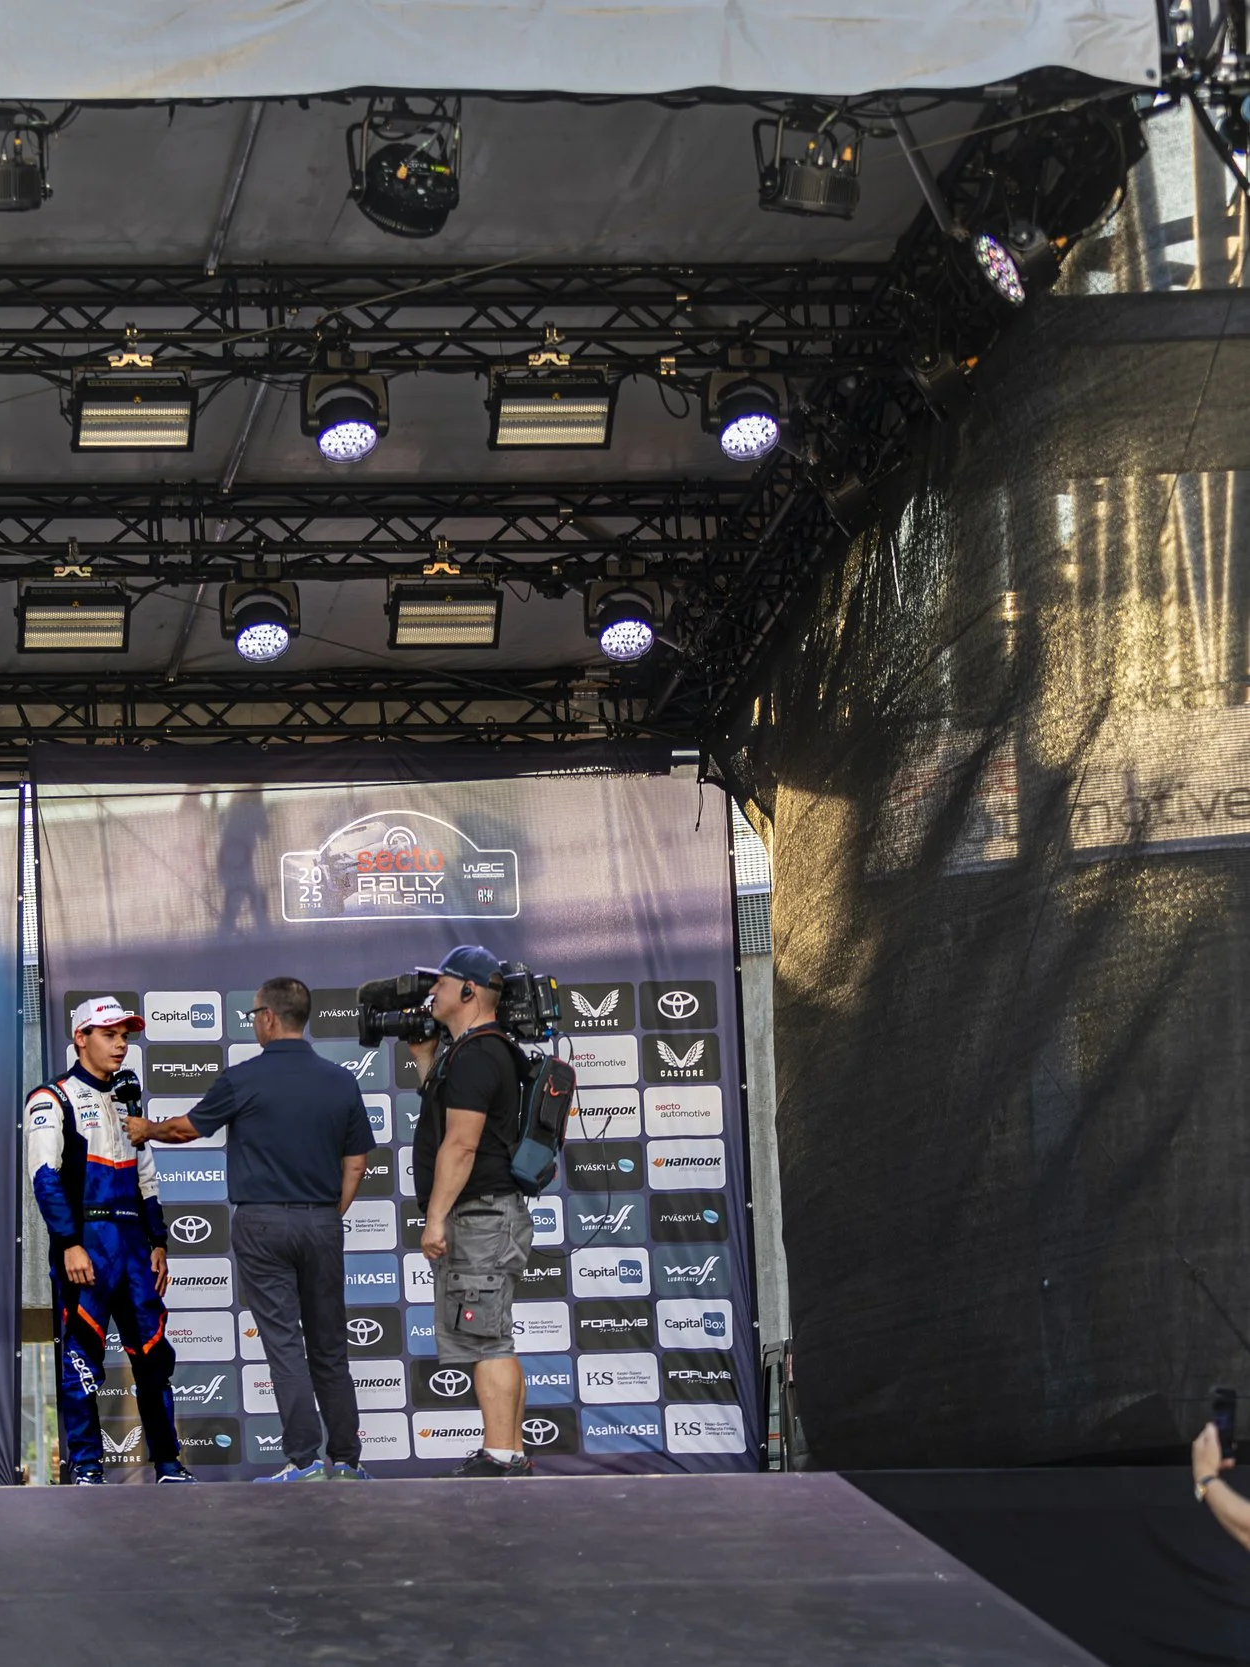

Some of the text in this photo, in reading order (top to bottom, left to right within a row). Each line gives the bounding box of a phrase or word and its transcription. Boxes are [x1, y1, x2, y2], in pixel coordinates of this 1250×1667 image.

[356, 846, 445, 873] secto
[462, 863, 504, 873] WRC
[299, 867, 322, 884] 20
[357, 876, 445, 892] RALLY
[299, 885, 322, 902] 25
[357, 893, 445, 905] FINLAND
[151, 1010, 213, 1022] CapitalBox
[574, 1018, 619, 1027] CASTORE
[152, 1063, 219, 1072] FORUM8
[660, 1069, 704, 1077] CASTORE
[80, 1111, 99, 1120] MAK
[660, 1109, 710, 1118] automotive
[574, 1162, 617, 1172] JYVÄSKYLÄ
[155, 1171, 224, 1182] AsahiKASEI
[577, 1204, 634, 1233] wolf
[659, 1213, 701, 1222] JYVÄSKYLÄ
[578, 1267, 642, 1278] CapitalBox
[663, 1255, 720, 1285] wolf
[412, 1271, 434, 1285] KS
[580, 1318, 648, 1328] FORUM8
[664, 1318, 725, 1331] CapitalBox
[172, 1335, 223, 1343] automotive
[67, 1350, 99, 1396] sparco
[586, 1371, 613, 1386] KS
[669, 1370, 731, 1380] FORUM8
[172, 1375, 226, 1404] wolf
[587, 1424, 658, 1436] AsahiKASEI
[674, 1421, 701, 1436] KS
